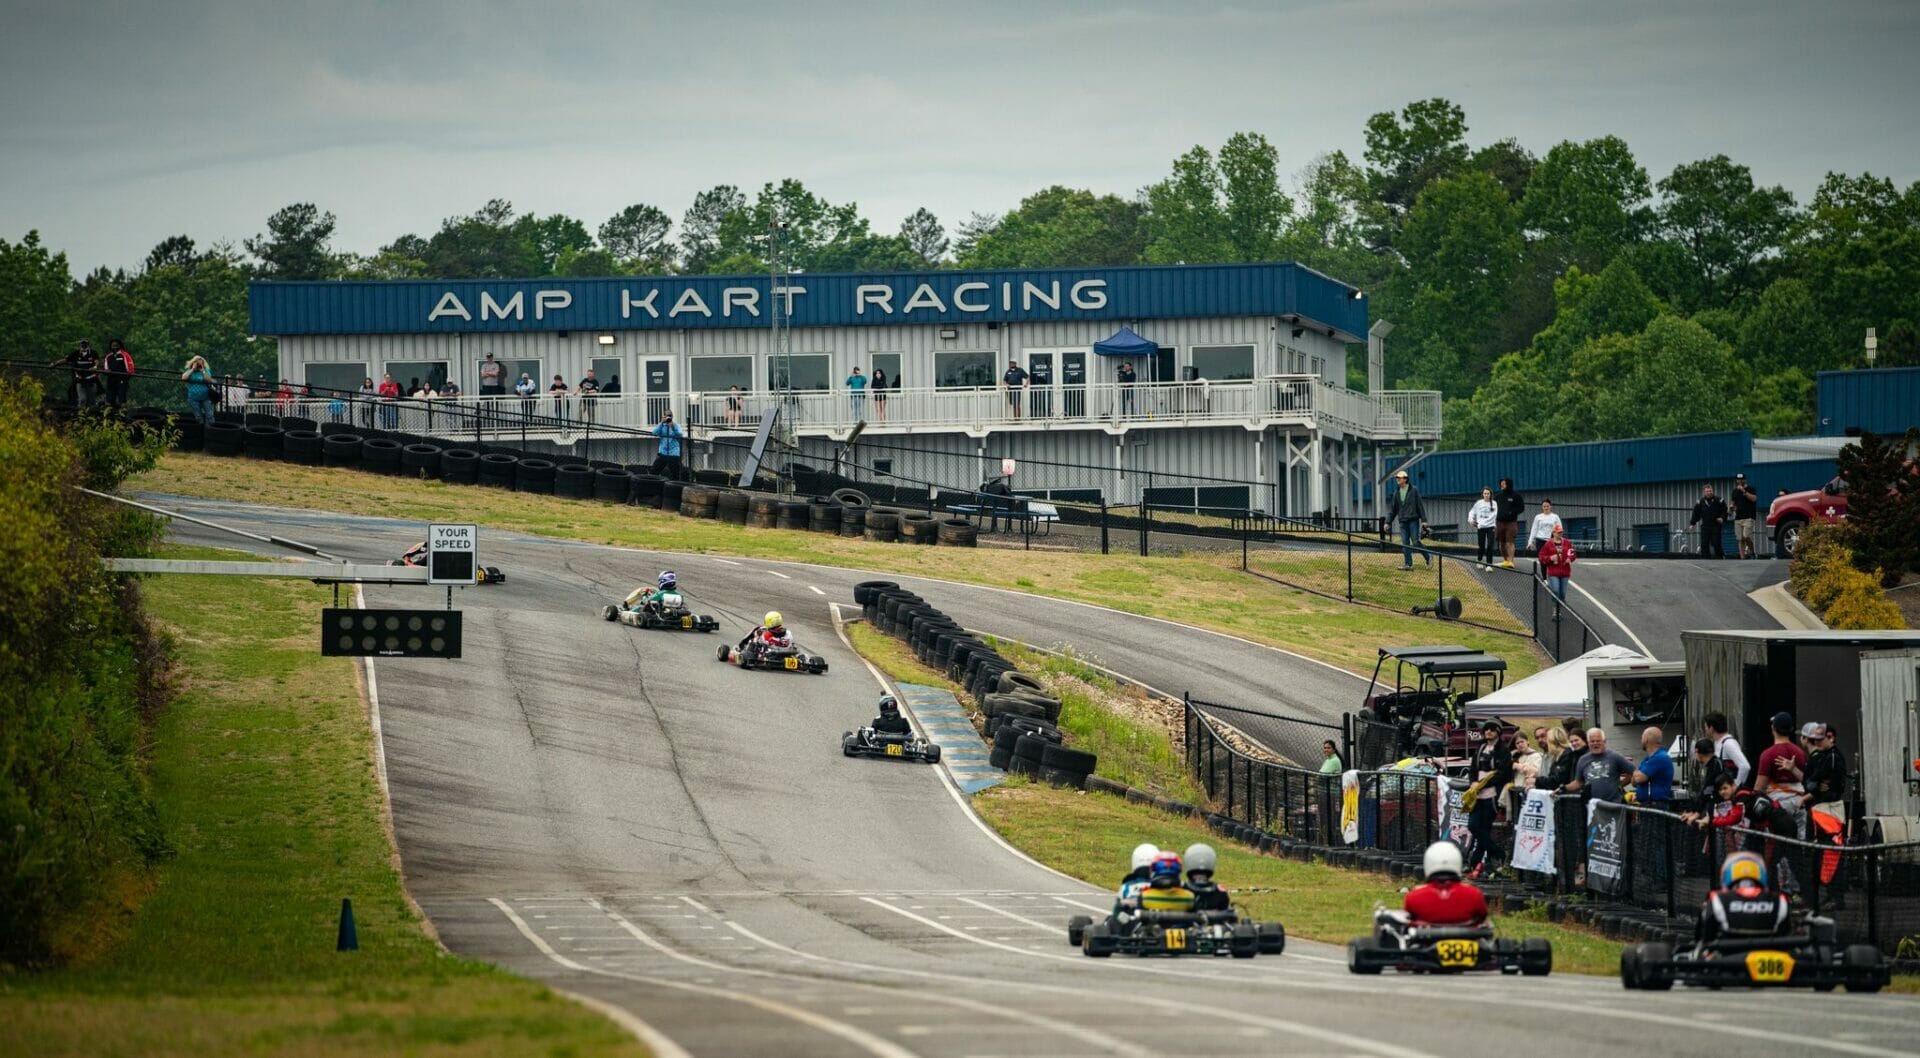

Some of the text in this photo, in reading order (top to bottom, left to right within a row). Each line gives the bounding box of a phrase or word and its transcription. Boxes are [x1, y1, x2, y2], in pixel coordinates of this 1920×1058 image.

[428, 279, 1107, 321] AMP KART RACING
[438, 528, 468, 537] YOUR
[435, 540, 471, 549] SPEED
[1729, 901, 1774, 914] SODI
[1169, 930, 1184, 946] 14
[1440, 942, 1478, 962] 384
